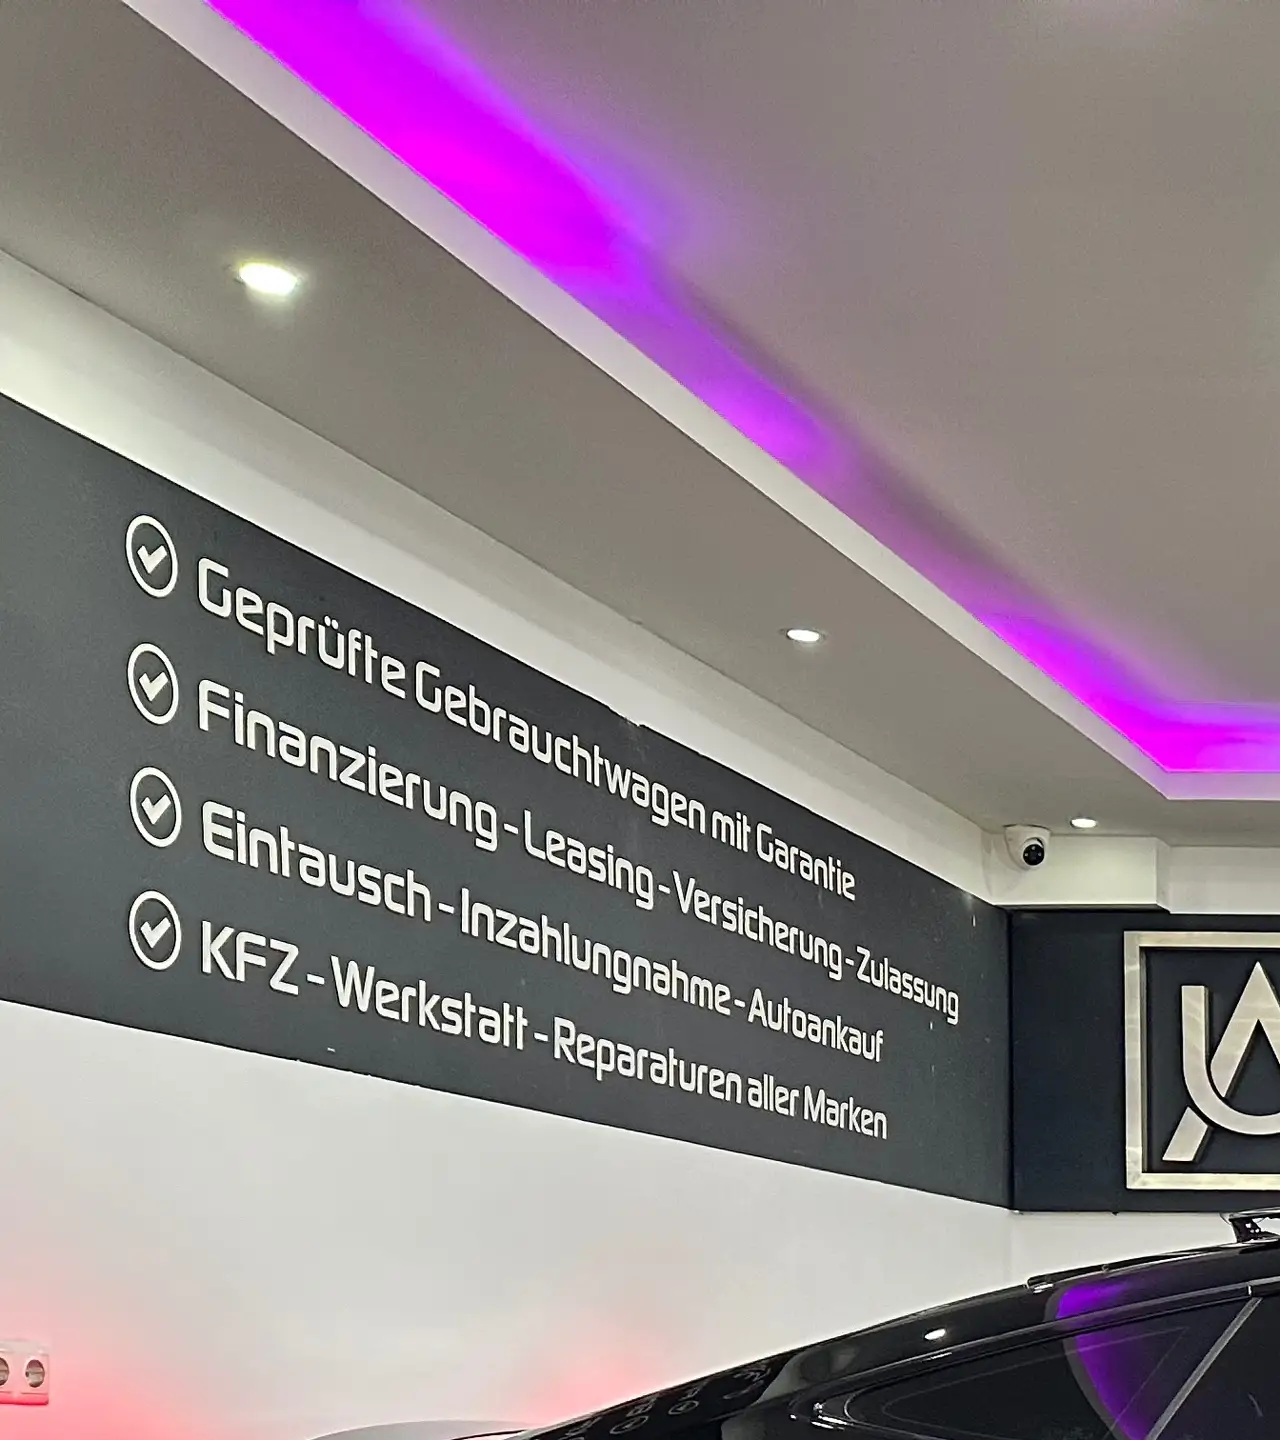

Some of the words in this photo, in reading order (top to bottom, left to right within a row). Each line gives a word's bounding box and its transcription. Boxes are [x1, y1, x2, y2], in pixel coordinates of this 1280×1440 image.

[198, 557, 406, 699] Geprüfte
[415, 661, 706, 835] Gebrauchtwagen
[711, 810, 751, 853] mit
[756, 822, 856, 901] Garantie
[198, 679, 498, 852] Finanzierung
[524, 809, 654, 911] Leasing
[672, 870, 843, 981] Versicherung
[856, 945, 959, 1026] Zulassung
[202, 800, 432, 922] Eintausch
[461, 887, 731, 1016] Inzahlungnahme
[747, 988, 884, 1063] Autoankauf
[202, 920, 300, 996] KFZ
[330, 955, 529, 1051] Werkstatt
[553, 1016, 743, 1104] Reparaturen
[747, 1074, 800, 1117] aller
[803, 1088, 887, 1140] Marken
